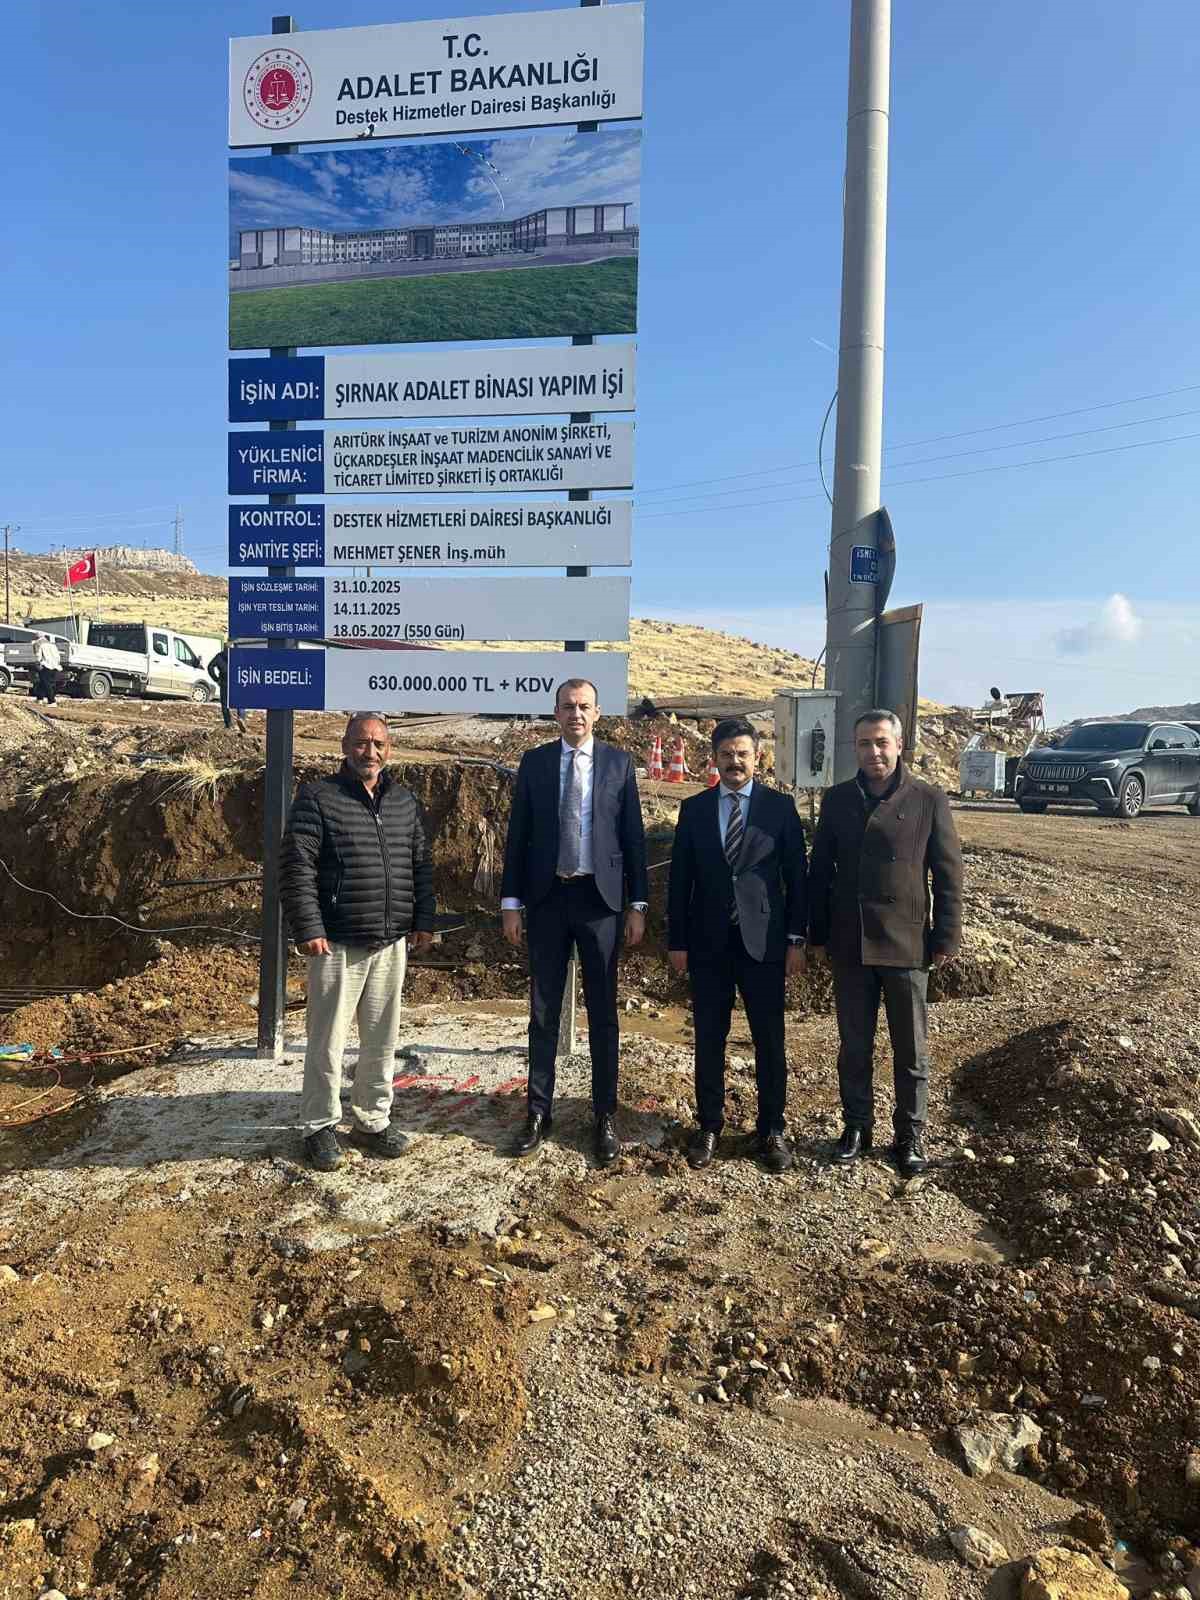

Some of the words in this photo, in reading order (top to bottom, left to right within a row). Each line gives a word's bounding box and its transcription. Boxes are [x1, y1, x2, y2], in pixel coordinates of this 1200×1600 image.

[442, 32, 489, 59] T.C.
[337, 70, 442, 101] ADALET
[451, 52, 600, 92] BAKANLIĞI
[335, 107, 389, 126] Destek
[393, 102, 467, 123] Hizmetler
[471, 97, 527, 117] Dairesi
[531, 89, 617, 114] Başkanlığı
[240, 379, 276, 405] İŞİN
[281, 381, 320, 400] ADI:
[335, 381, 399, 408] ŞIRNAK
[403, 379, 470, 401] ADALET
[475, 374, 533, 399] BİNASI
[539, 374, 596, 397] YAPIM
[602, 368, 624, 399] İŞİ
[333, 432, 385, 449] ARITÜRK
[388, 431, 431, 449] İNŞAAT
[434, 435, 449, 446] ve
[451, 427, 500, 445] TURİZM
[503, 425, 558, 443] ANONİM
[561, 422, 612, 445] ŞİRKETİ,
[238, 444, 323, 464] YÜKLENİCİ
[333, 451, 418, 470] ÜÇKARDEŞLER
[420, 450, 464, 468] İNŞAAT
[467, 446, 544, 464] MADENCİLİK
[547, 442, 592, 461] SANAYİ
[596, 444, 612, 459] VE
[253, 466, 307, 483] FİRMA:
[333, 471, 381, 487] TİCARET
[385, 469, 434, 487] LİMİTED
[437, 469, 482, 488] ŞİRKETİ
[485, 467, 496, 485] İŞ
[499, 464, 563, 483] ORTAKLIĞI
[239, 510, 321, 527] KONTROL:
[333, 512, 383, 528] DESTEK
[386, 508, 466, 528] HİZMETLERİ
[470, 508, 524, 527] DAİRESİ
[527, 506, 611, 529] BAŞKANLIĞI
[239, 539, 290, 563] ŞANTİYE
[292, 539, 322, 563] ŞEFİ:
[333, 545, 395, 560] MEHMET
[398, 544, 441, 563] ŞENER
[447, 542, 506, 562] İnş.müh
[256, 581, 293, 594] SÖZLEŞME
[333, 580, 401, 593] 31.10.2025
[253, 603, 267, 612] YER
[269, 601, 294, 612] TESLİM
[333, 602, 401, 616] 14.11.2025
[333, 624, 401, 638] 18.05.2027
[404, 623, 431, 640] (550
[434, 623, 465, 640] Gün)
[237, 666, 261, 687] İŞİN
[264, 667, 313, 686] BEDELİ:
[368, 675, 467, 692] 630.000.000
[472, 676, 495, 692] TL
[499, 679, 510, 691] +
[515, 676, 555, 693] KDV
